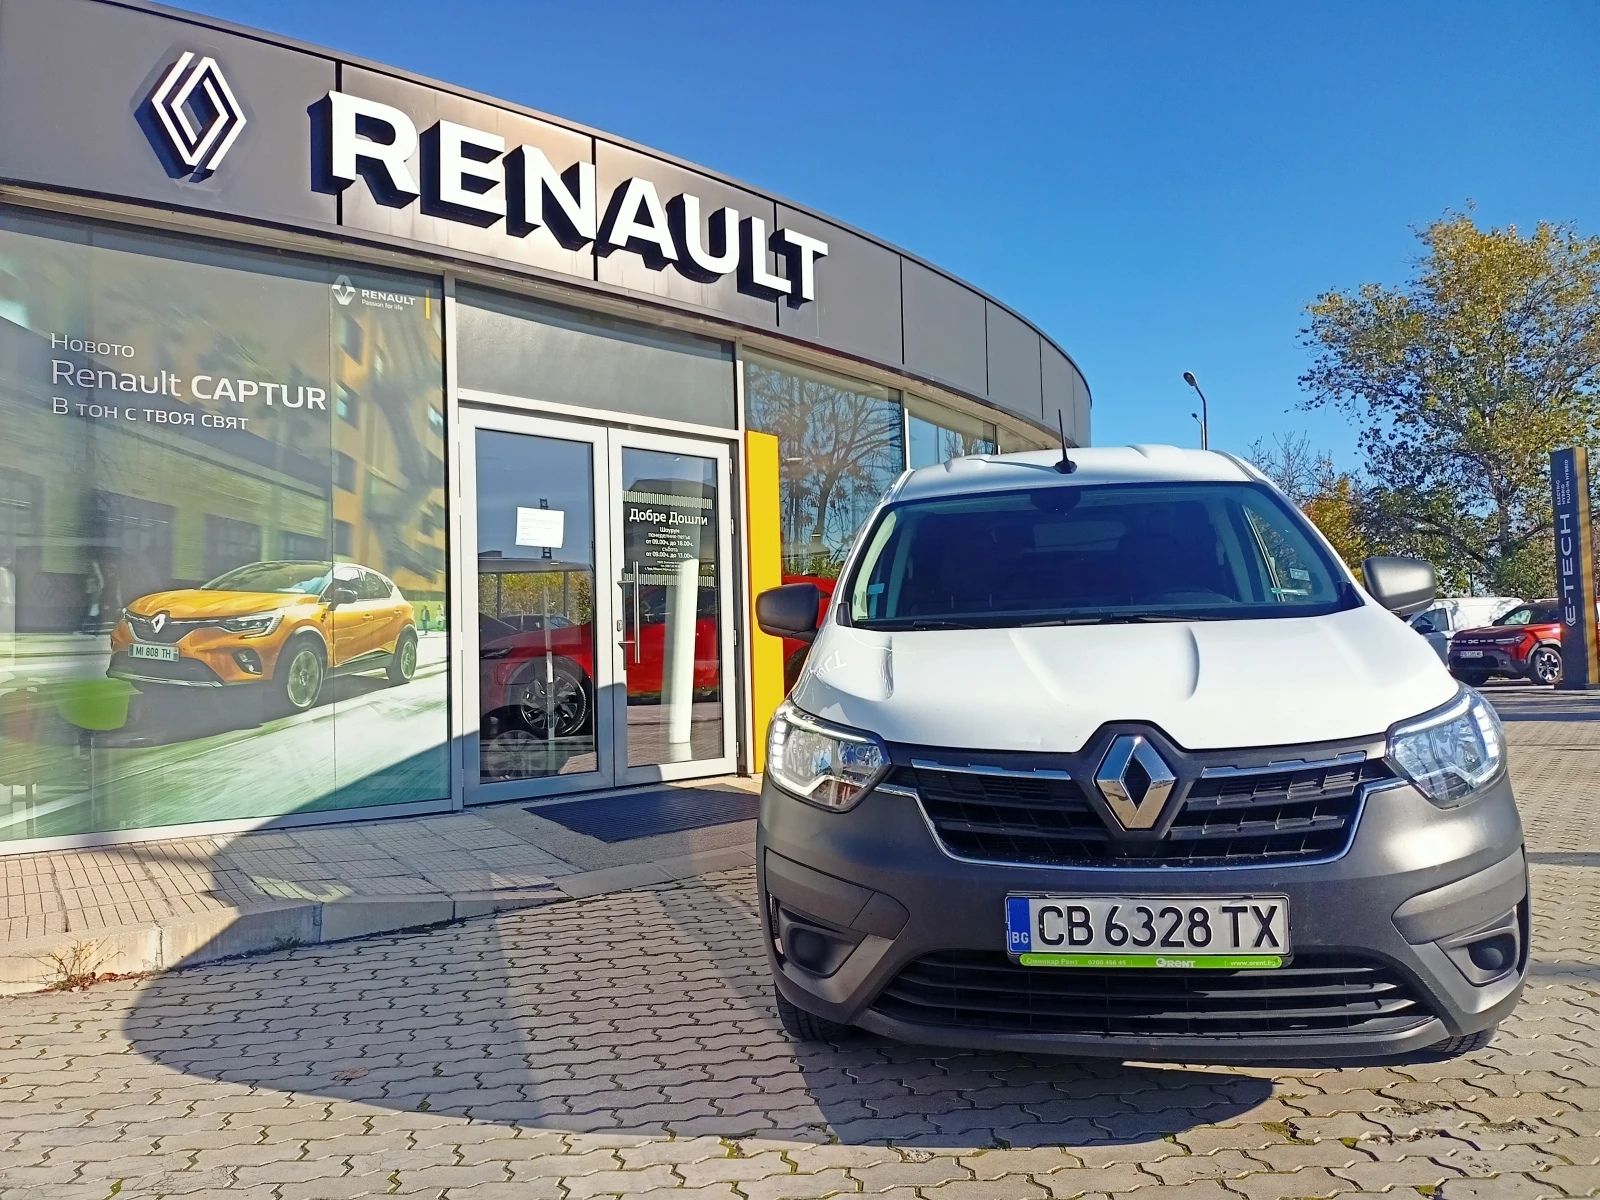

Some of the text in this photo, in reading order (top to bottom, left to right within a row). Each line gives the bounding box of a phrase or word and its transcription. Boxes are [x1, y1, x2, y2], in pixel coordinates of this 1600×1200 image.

[326, 90, 829, 301] RENAULT
[361, 289, 416, 305] RENAULT
[361, 299, 403, 311] Passion for life
[50, 333, 135, 358] Новото
[51, 359, 327, 411] Renault CAPTUR
[52, 397, 249, 430] В тон с твоя свят
[629, 508, 708, 526] Добре Дошли
[1560, 513, 1576, 627] E-TECH
[135, 646, 171, 658] MI 808 TH
[1011, 931, 1029, 944] BG
[1038, 905, 1280, 948] CB 6328 TX
